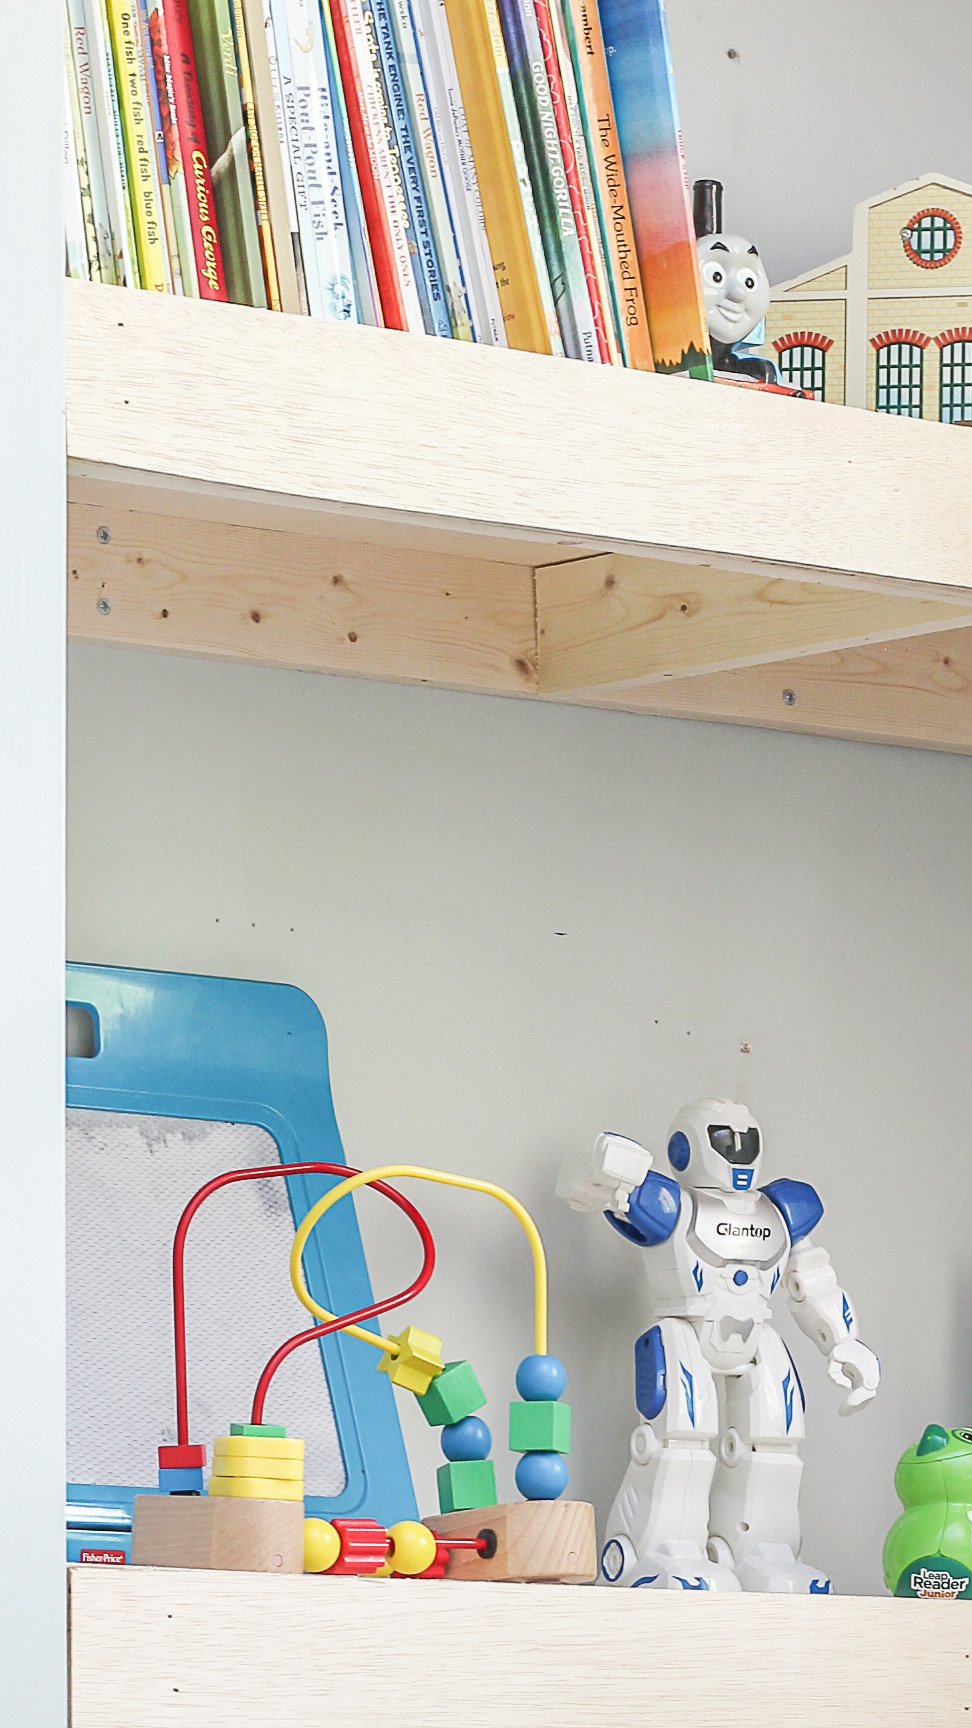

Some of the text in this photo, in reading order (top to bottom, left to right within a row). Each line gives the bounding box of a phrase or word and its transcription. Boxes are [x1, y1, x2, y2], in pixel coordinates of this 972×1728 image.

[398, 1, 409, 29] wska
[580, 3, 595, 56] ambert
[74, 26, 92, 115] Red Wagon
[220, 28, 238, 77] Verdi
[121, 12, 159, 245] One fish two fish red fish blue fish
[285, 92, 302, 165] SPECIAL
[297, 171, 308, 211] GIFT
[376, 1, 442, 302] HE TANK ENGINE: THE VERY FIRST STORIES
[415, 92, 438, 180] Red Wagon
[531, 60, 550, 108] GOOD
[551, 165, 576, 238] GORILLA
[191, 151, 211, 222] Curious
[598, 114, 639, 328] The Wide-Mouthed Frog
[200, 225, 219, 291] George
[582, 331, 595, 363] Putna
[716, 1222, 771, 1241] Glantop
[913, 1576, 967, 1590] Reader
[920, 1590, 957, 1599] Junior
[923, 1570, 949, 1582] Leap
